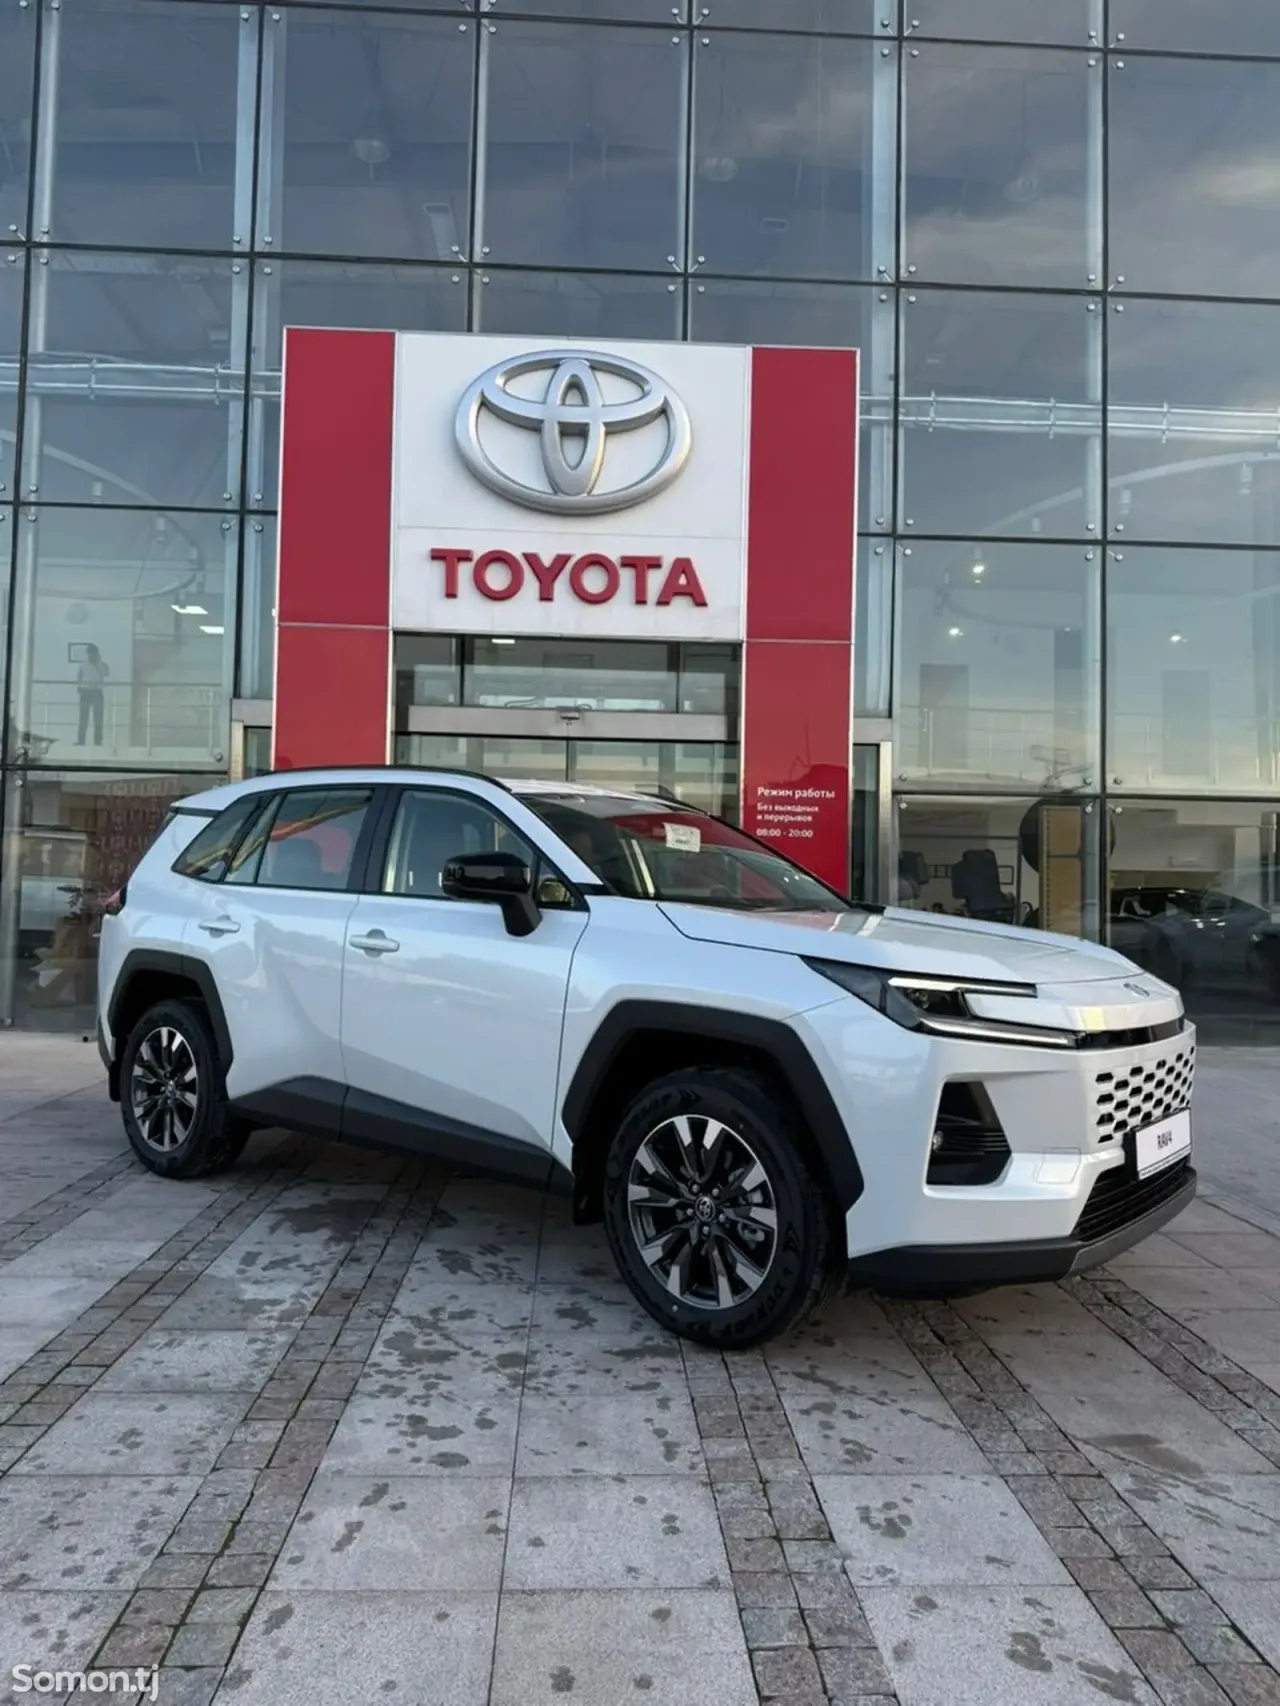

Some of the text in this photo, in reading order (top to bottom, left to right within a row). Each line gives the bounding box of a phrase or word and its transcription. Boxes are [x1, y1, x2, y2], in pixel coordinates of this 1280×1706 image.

[430, 548, 708, 607] TOYOTA
[757, 787, 836, 800] Режим работы
[757, 802, 773, 811] Без
[788, 829, 814, 837] 20:00
